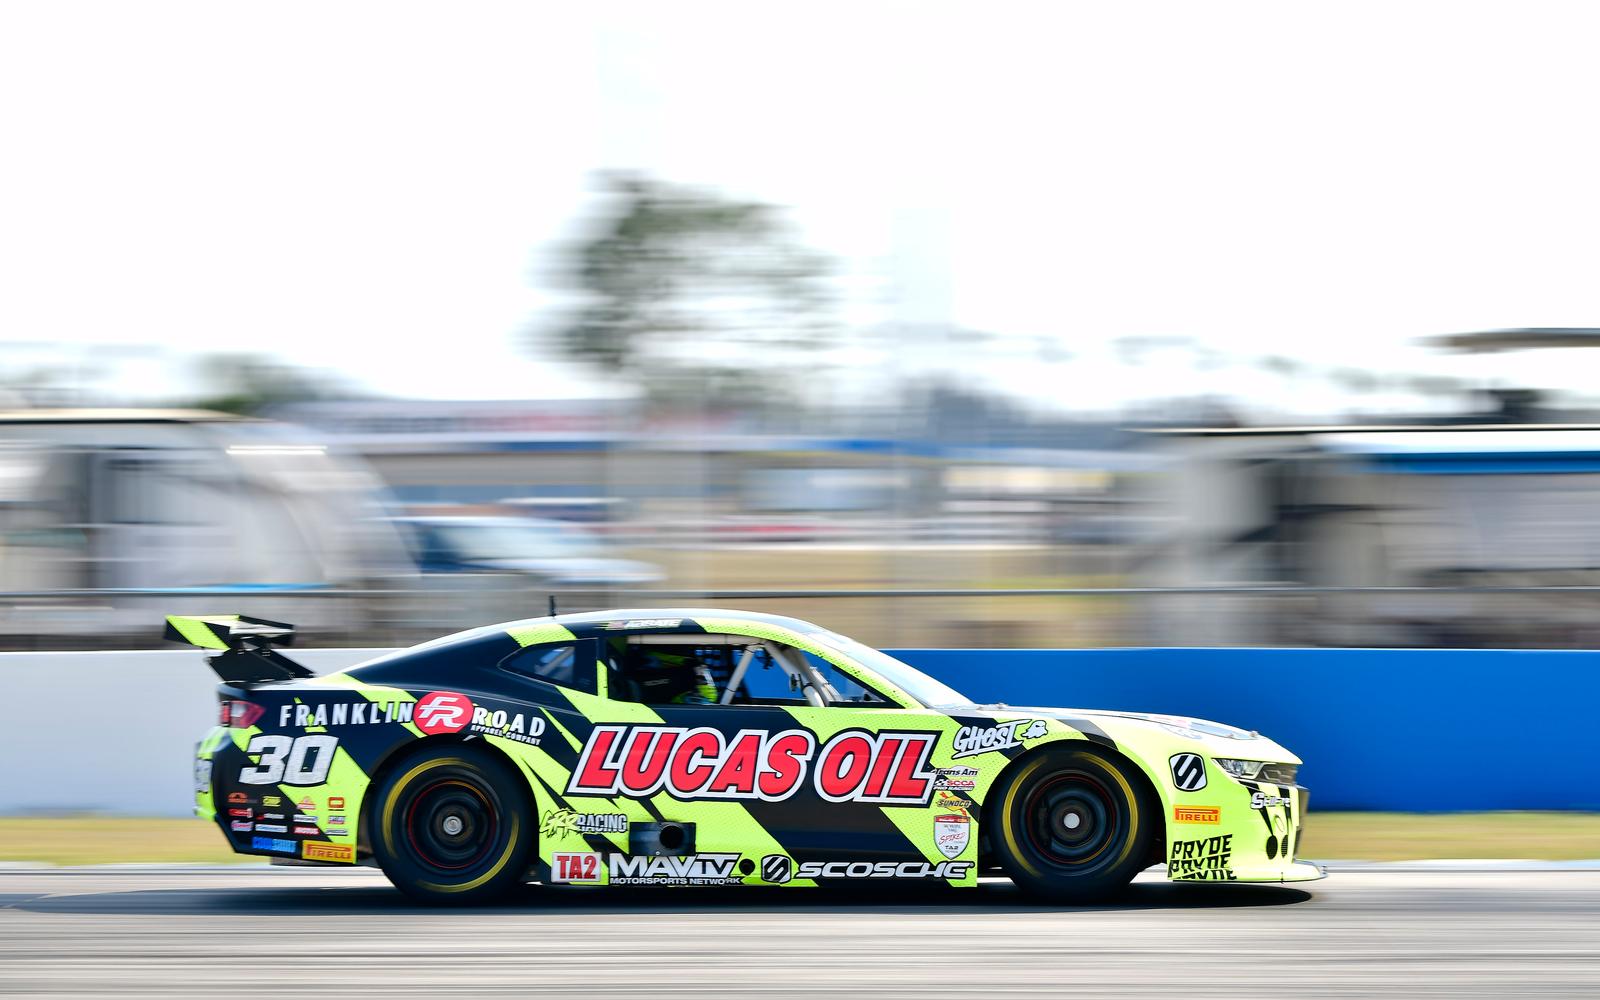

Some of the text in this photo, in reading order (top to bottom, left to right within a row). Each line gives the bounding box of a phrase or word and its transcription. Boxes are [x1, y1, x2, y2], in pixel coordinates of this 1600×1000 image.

[279, 702, 414, 727] FRANKLIN
[472, 707, 546, 737] ROAD
[470, 724, 542, 746] APPAREL COMPANY
[952, 719, 1033, 759] GHOST
[238, 734, 340, 785] 30
[566, 726, 937, 804] LUCAS OIL
[935, 768, 978, 776] Trans Am
[938, 799, 970, 807] SUNOCO
[577, 813, 628, 833] RACING
[1174, 807, 1219, 822] PIRELLI
[306, 844, 352, 859] PIRELLI
[1171, 834, 1232, 859] PRYDE
[557, 855, 597, 879] TA2
[796, 862, 970, 878] SCOSCHE
[610, 877, 741, 885] MOTORSPORTS NETWORK
